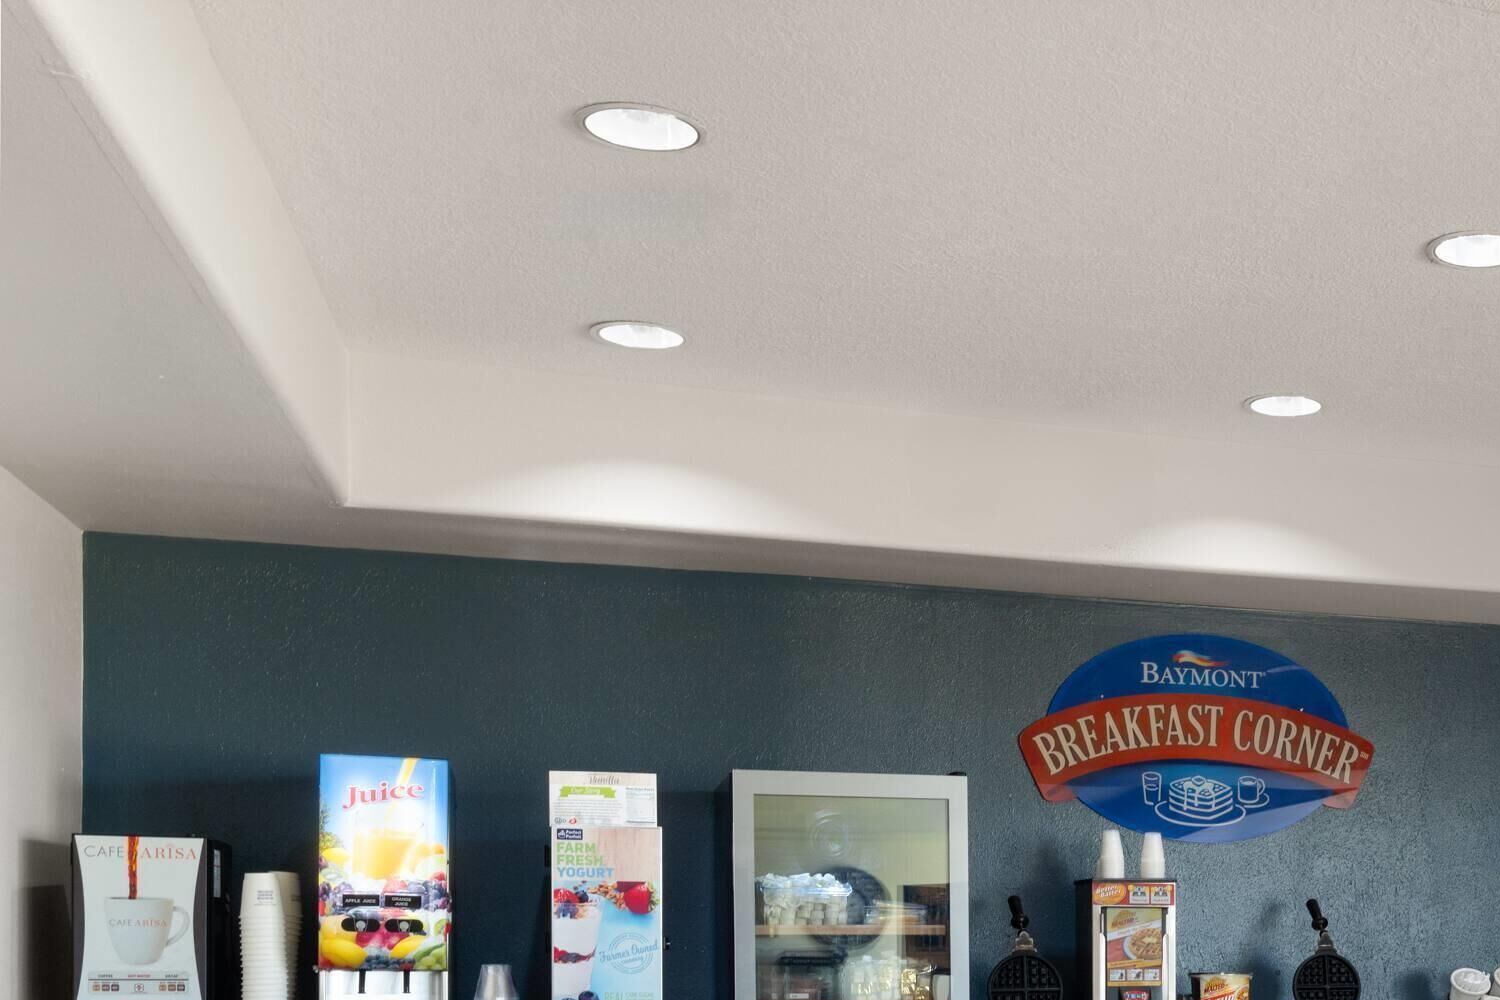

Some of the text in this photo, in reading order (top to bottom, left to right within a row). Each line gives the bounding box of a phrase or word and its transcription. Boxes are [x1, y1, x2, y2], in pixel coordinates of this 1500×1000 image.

[1140, 661, 1263, 689] BAYMONT
[1033, 704, 1224, 775] BREAKFAST
[1234, 710, 1359, 784] CORNER
[342, 782, 424, 809] Juice
[84, 845, 124, 858] CAFE
[557, 842, 596, 853] FARM
[557, 854, 604, 866] FRESH
[557, 867, 615, 878] YOGURT
[108, 919, 133, 927] CAFE
[631, 939, 658, 955] Owned
